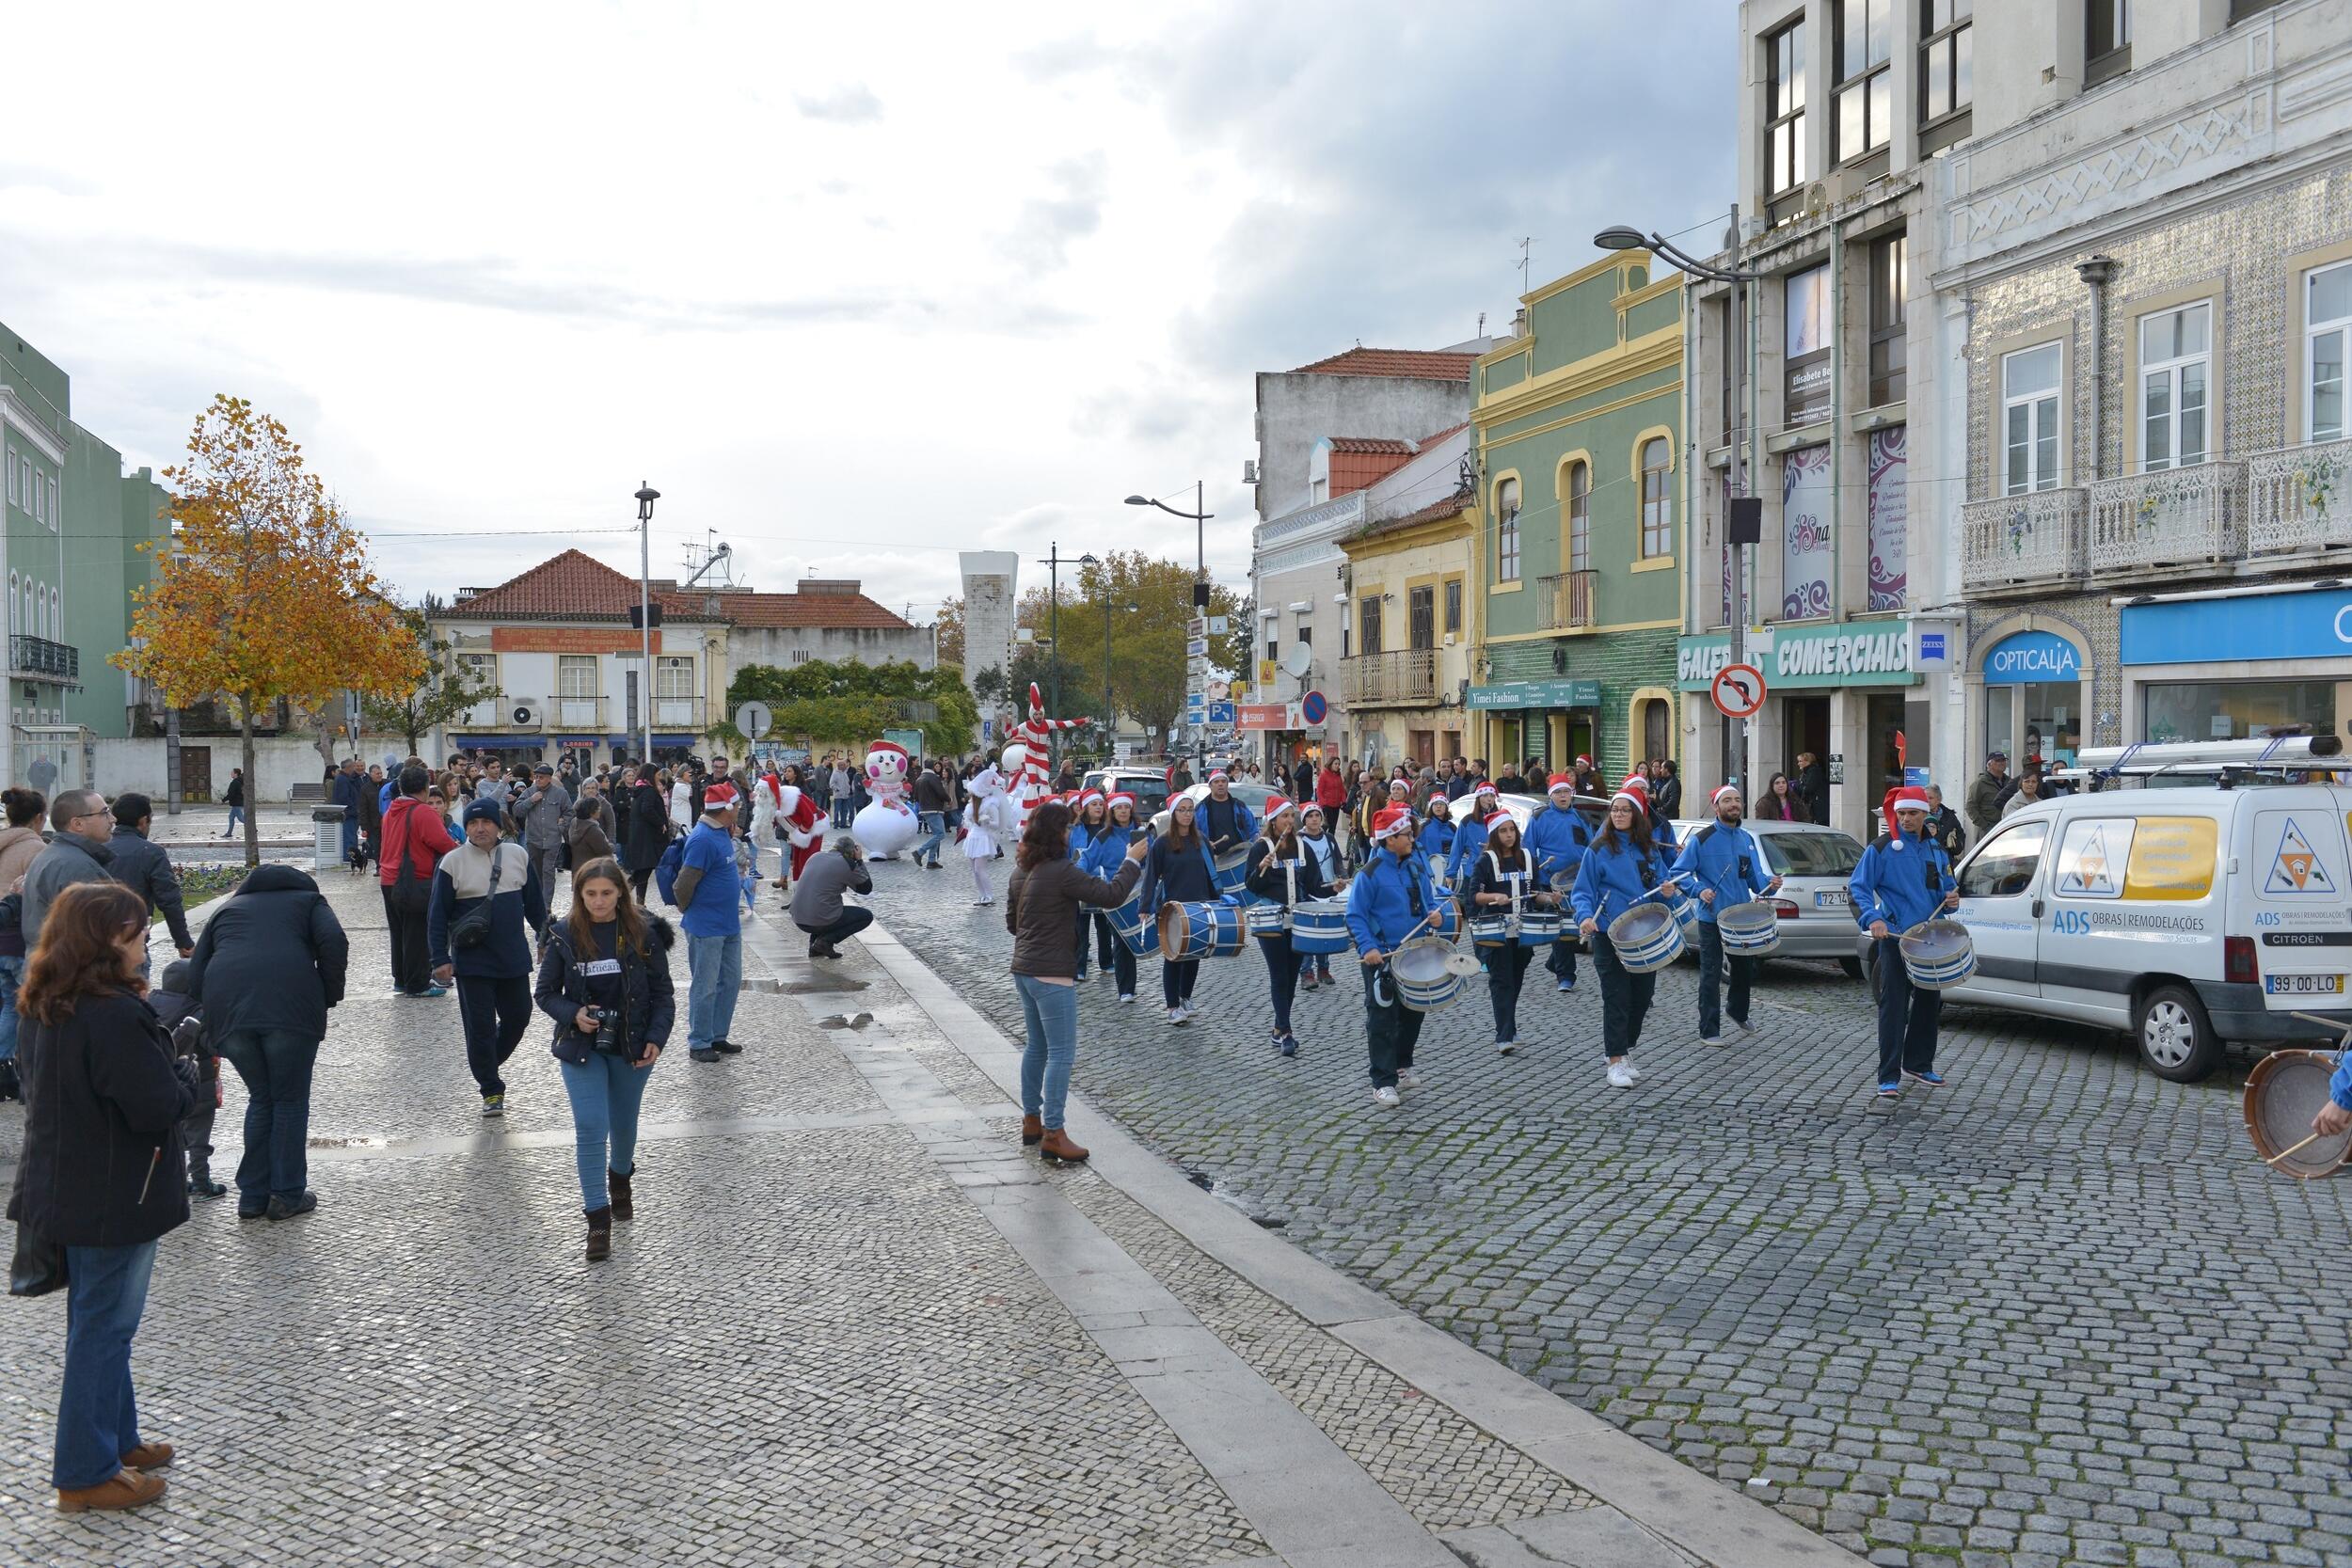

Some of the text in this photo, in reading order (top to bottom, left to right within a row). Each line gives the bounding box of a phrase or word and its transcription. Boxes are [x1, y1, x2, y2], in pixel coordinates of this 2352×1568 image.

[1792, 370, 1821, 386] Elisabete
[1777, 632, 1908, 676] COMERCIAIS
[1472, 692, 1492, 704] Yimei
[1492, 691, 1519, 703] Fashion
[2052, 910, 2204, 935] ADS OBRAS REMODELAÇÕES
[2255, 912, 2280, 926] ADS
[2303, 911, 2345, 919] REMODELAÇÕES
[2175, 934, 2198, 943] Seixas
[2272, 934, 2323, 943] CITROËN
